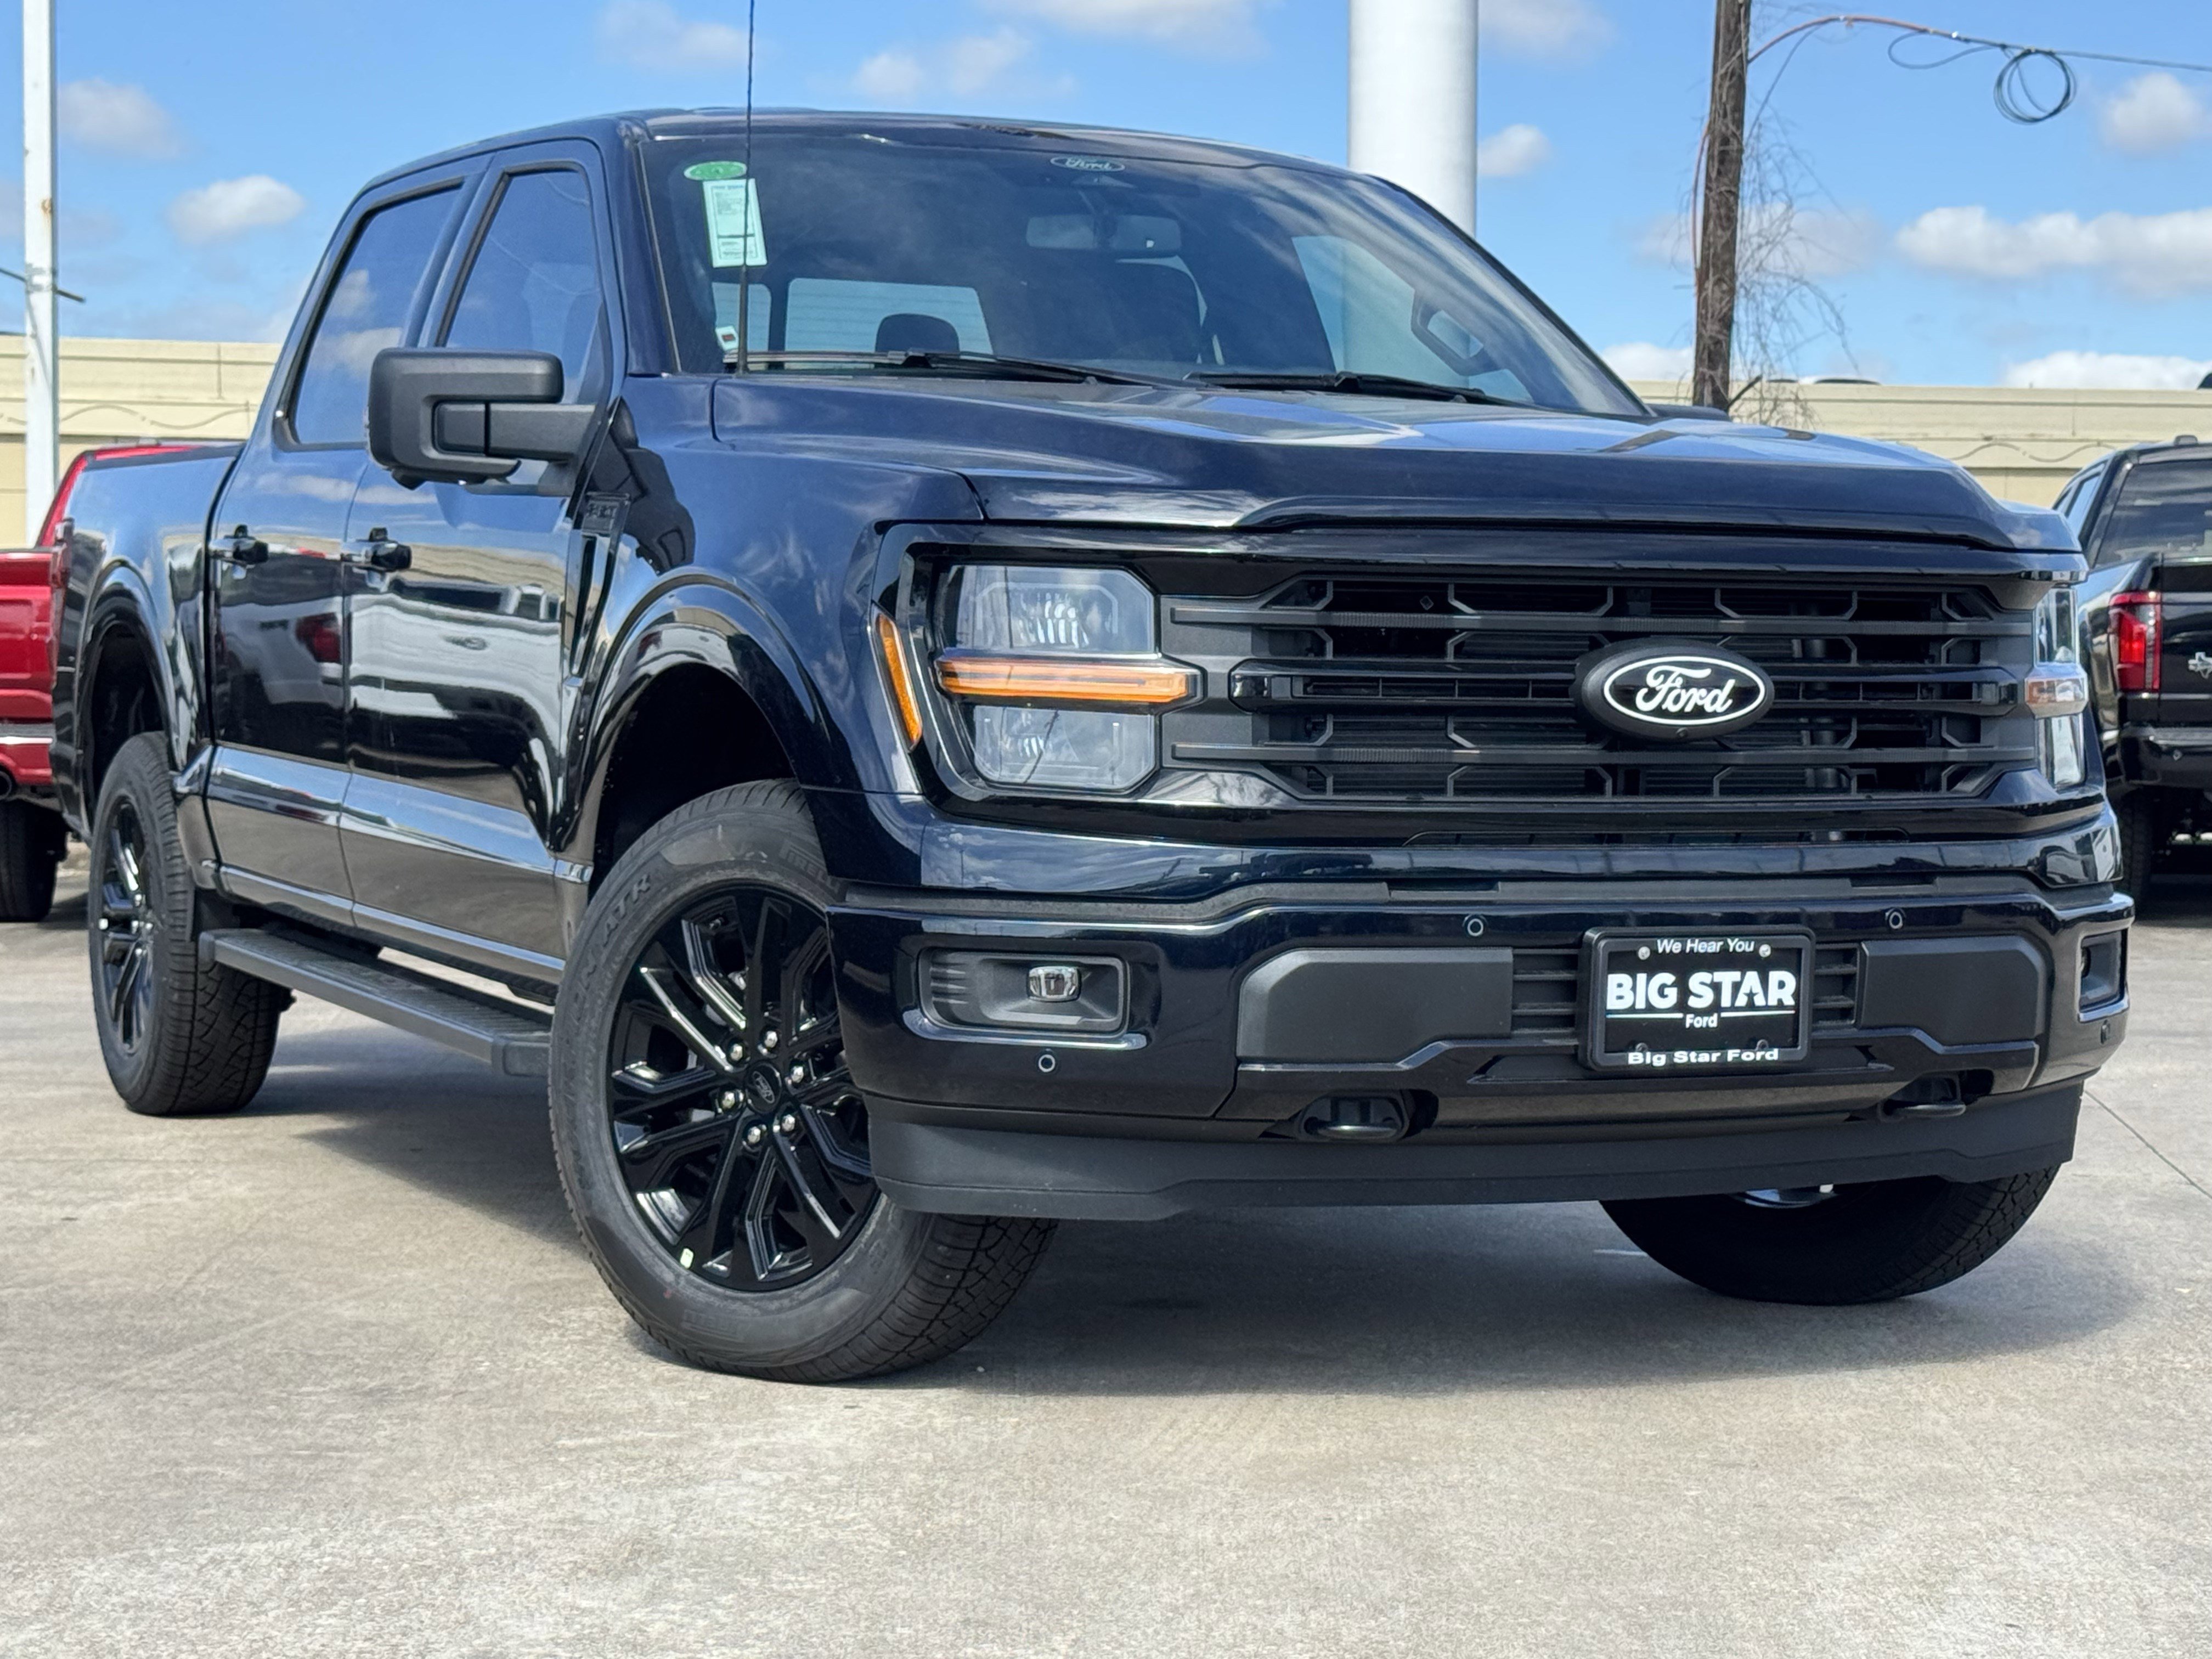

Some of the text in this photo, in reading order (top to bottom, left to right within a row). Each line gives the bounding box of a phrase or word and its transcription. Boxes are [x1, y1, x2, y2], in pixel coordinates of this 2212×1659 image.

[1064, 157, 1113, 171] Ford
[1635, 664, 1736, 713] Ford
[1657, 938, 1755, 954] We Hear You
[1606, 970, 1797, 1010] BIG STAR
[1685, 1013, 1718, 1029] Ford
[1627, 1048, 1779, 1066] Big Star Ford
